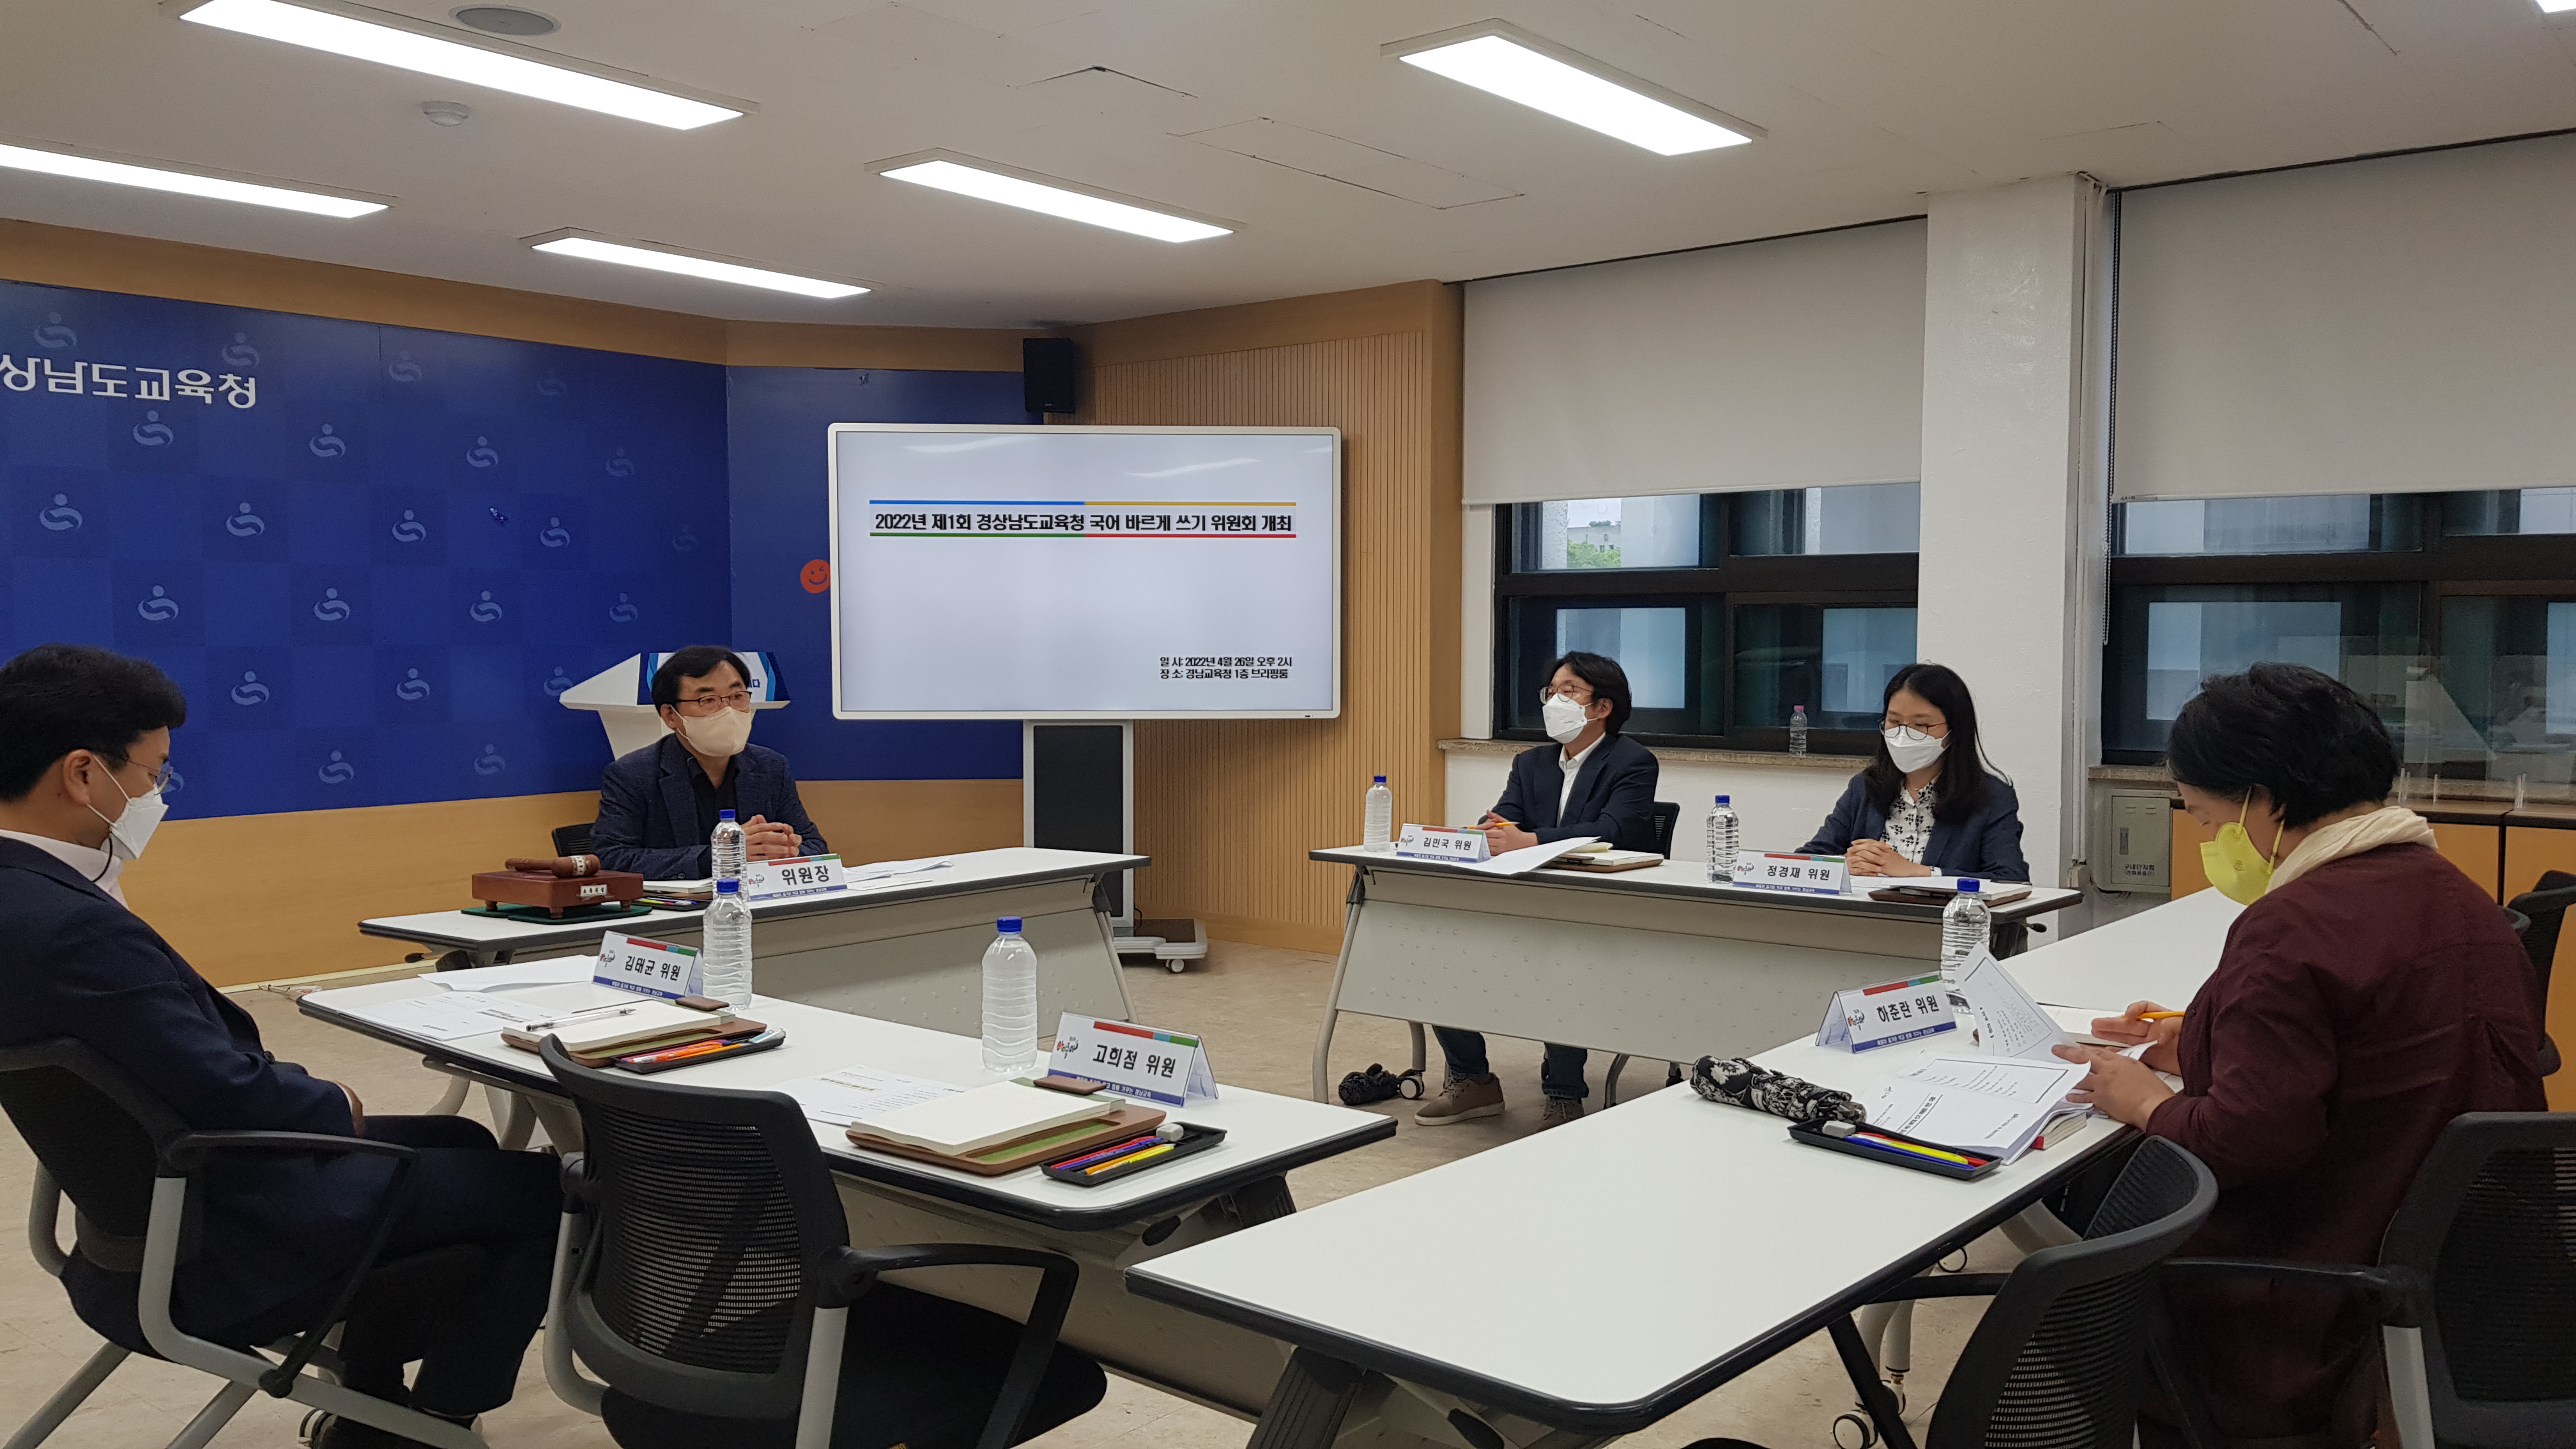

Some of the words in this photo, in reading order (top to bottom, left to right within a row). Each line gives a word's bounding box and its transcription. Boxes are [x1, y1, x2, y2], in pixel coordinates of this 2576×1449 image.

[0, 354, 256, 409] 상남도교육청
[875, 513, 926, 530] 2022년
[931, 514, 971, 530] 제1회
[976, 514, 1084, 531] 경상남도교육청
[1089, 514, 1119, 531] 국어
[1125, 515, 1170, 532] 바르게
[1176, 515, 1206, 531] 쓰기
[1211, 515, 1256, 532] 위원회
[1261, 515, 1291, 532] 개최
[1160, 657, 1170, 667] 일
[1185, 657, 1215, 667] 2022년
[1217, 657, 1232, 667] 4월
[1234, 657, 1254, 667] 26일
[1257, 657, 1275, 667] 오후
[1277, 657, 1292, 667] 2시
[1160, 669, 1170, 679] 장
[1186, 669, 1232, 679] 경남교육청
[1235, 669, 1249, 679] 1층
[1251, 669, 1288, 679] 브리핑룸
[1423, 837, 1449, 849] 김민국
[1454, 840, 1471, 850] 위원
[781, 865, 830, 885] 위원장
[1767, 865, 1800, 878] 정경재
[1807, 868, 1830, 881] 위원
[624, 955, 656, 976] 김태균
[660, 963, 681, 981] 위원
[1876, 1000, 1913, 1022] 하춘란
[1915, 995, 1940, 1015] 위원
[1092, 1044, 1138, 1070] 고희점
[1146, 1054, 1176, 1078] 위원
